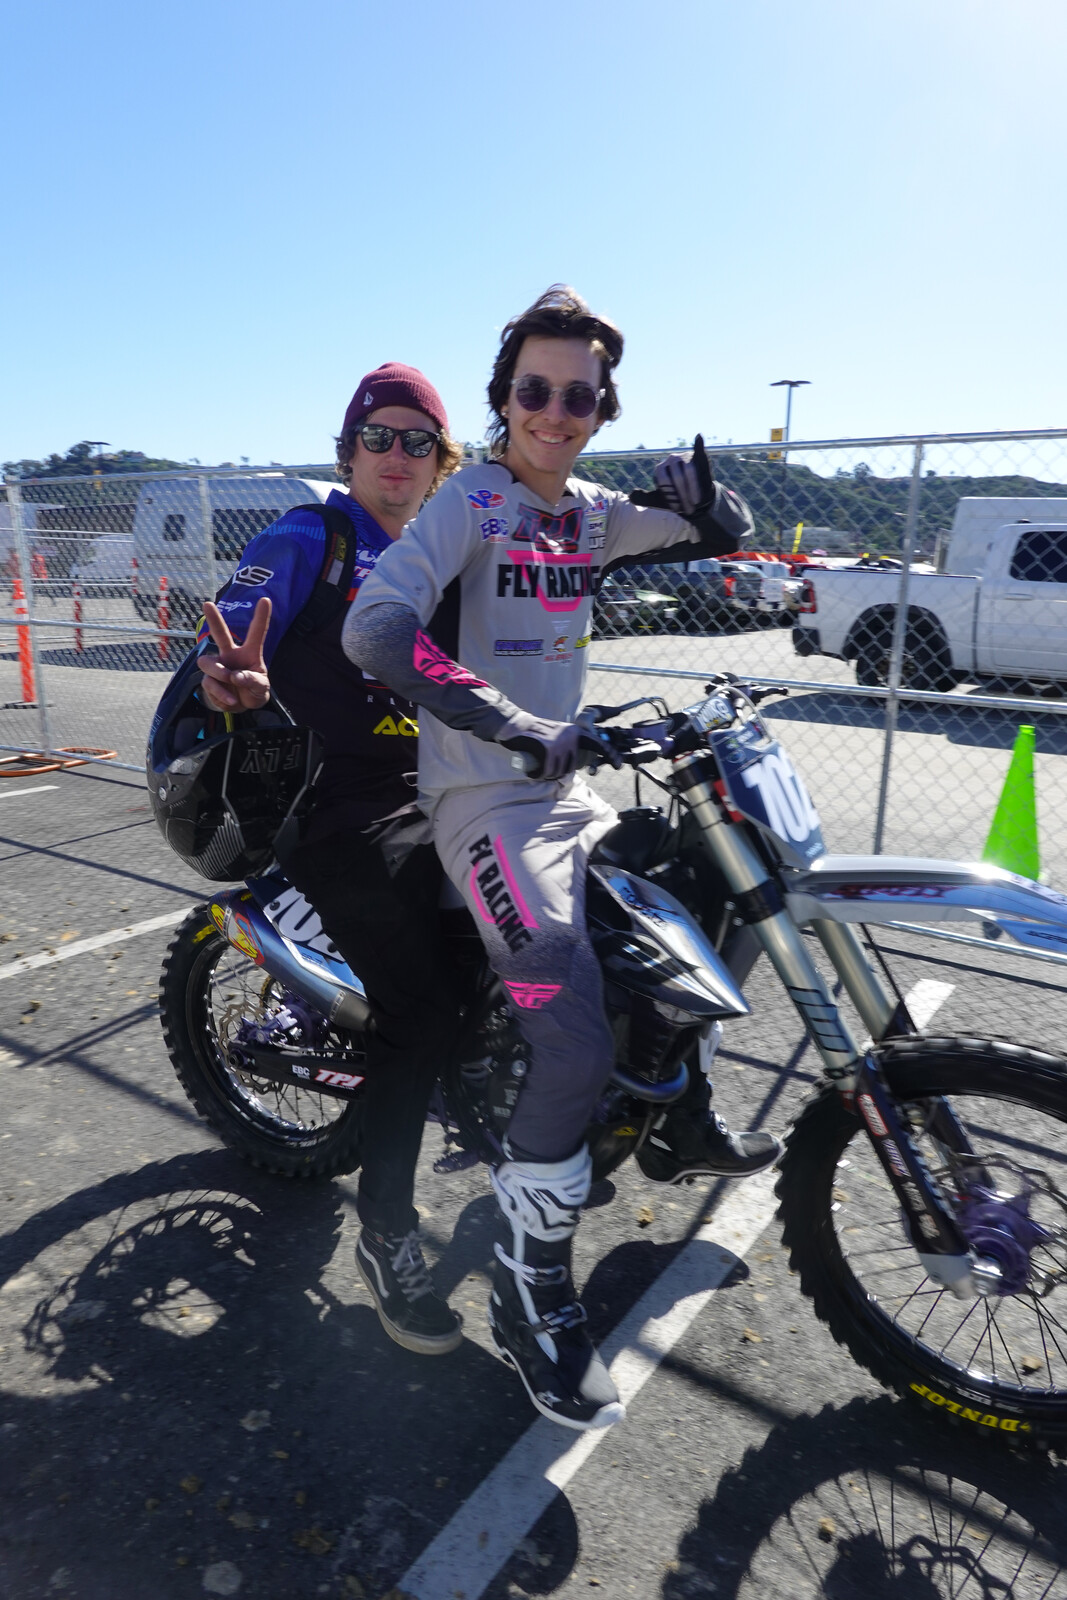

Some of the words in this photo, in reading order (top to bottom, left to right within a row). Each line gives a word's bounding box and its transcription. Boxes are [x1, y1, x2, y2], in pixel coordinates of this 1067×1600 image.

[497, 564, 541, 597] FLY
[547, 565, 601, 598] RACING
[477, 864, 534, 954] RACING
[292, 1064, 310, 1076] EBC
[314, 1069, 365, 1088] TPJ
[909, 1382, 1021, 1432] DUNLOP
